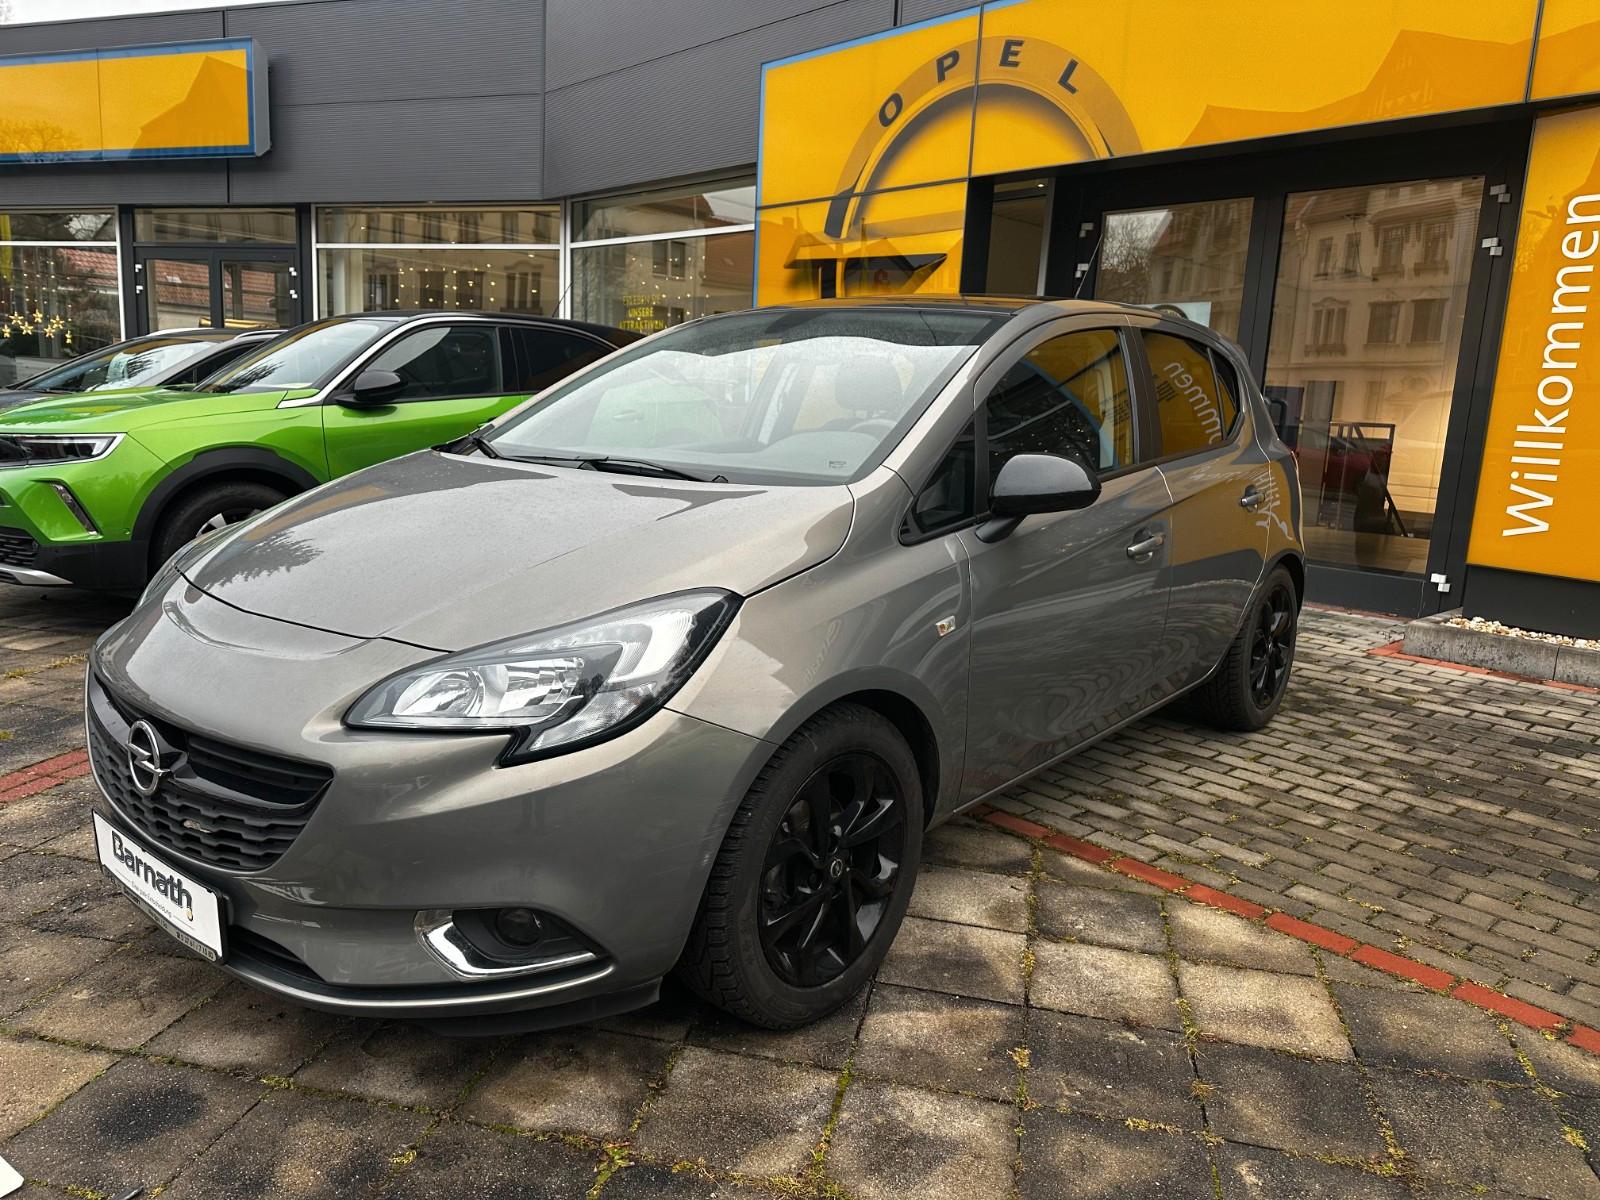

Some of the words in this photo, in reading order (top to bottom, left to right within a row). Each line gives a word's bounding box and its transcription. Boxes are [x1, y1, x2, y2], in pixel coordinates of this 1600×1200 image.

[878, 39, 1080, 128] OPEL
[628, 307, 654, 318] UNSERE
[1502, 193, 1600, 537] Willkommen
[111, 830, 194, 921] Barnath
